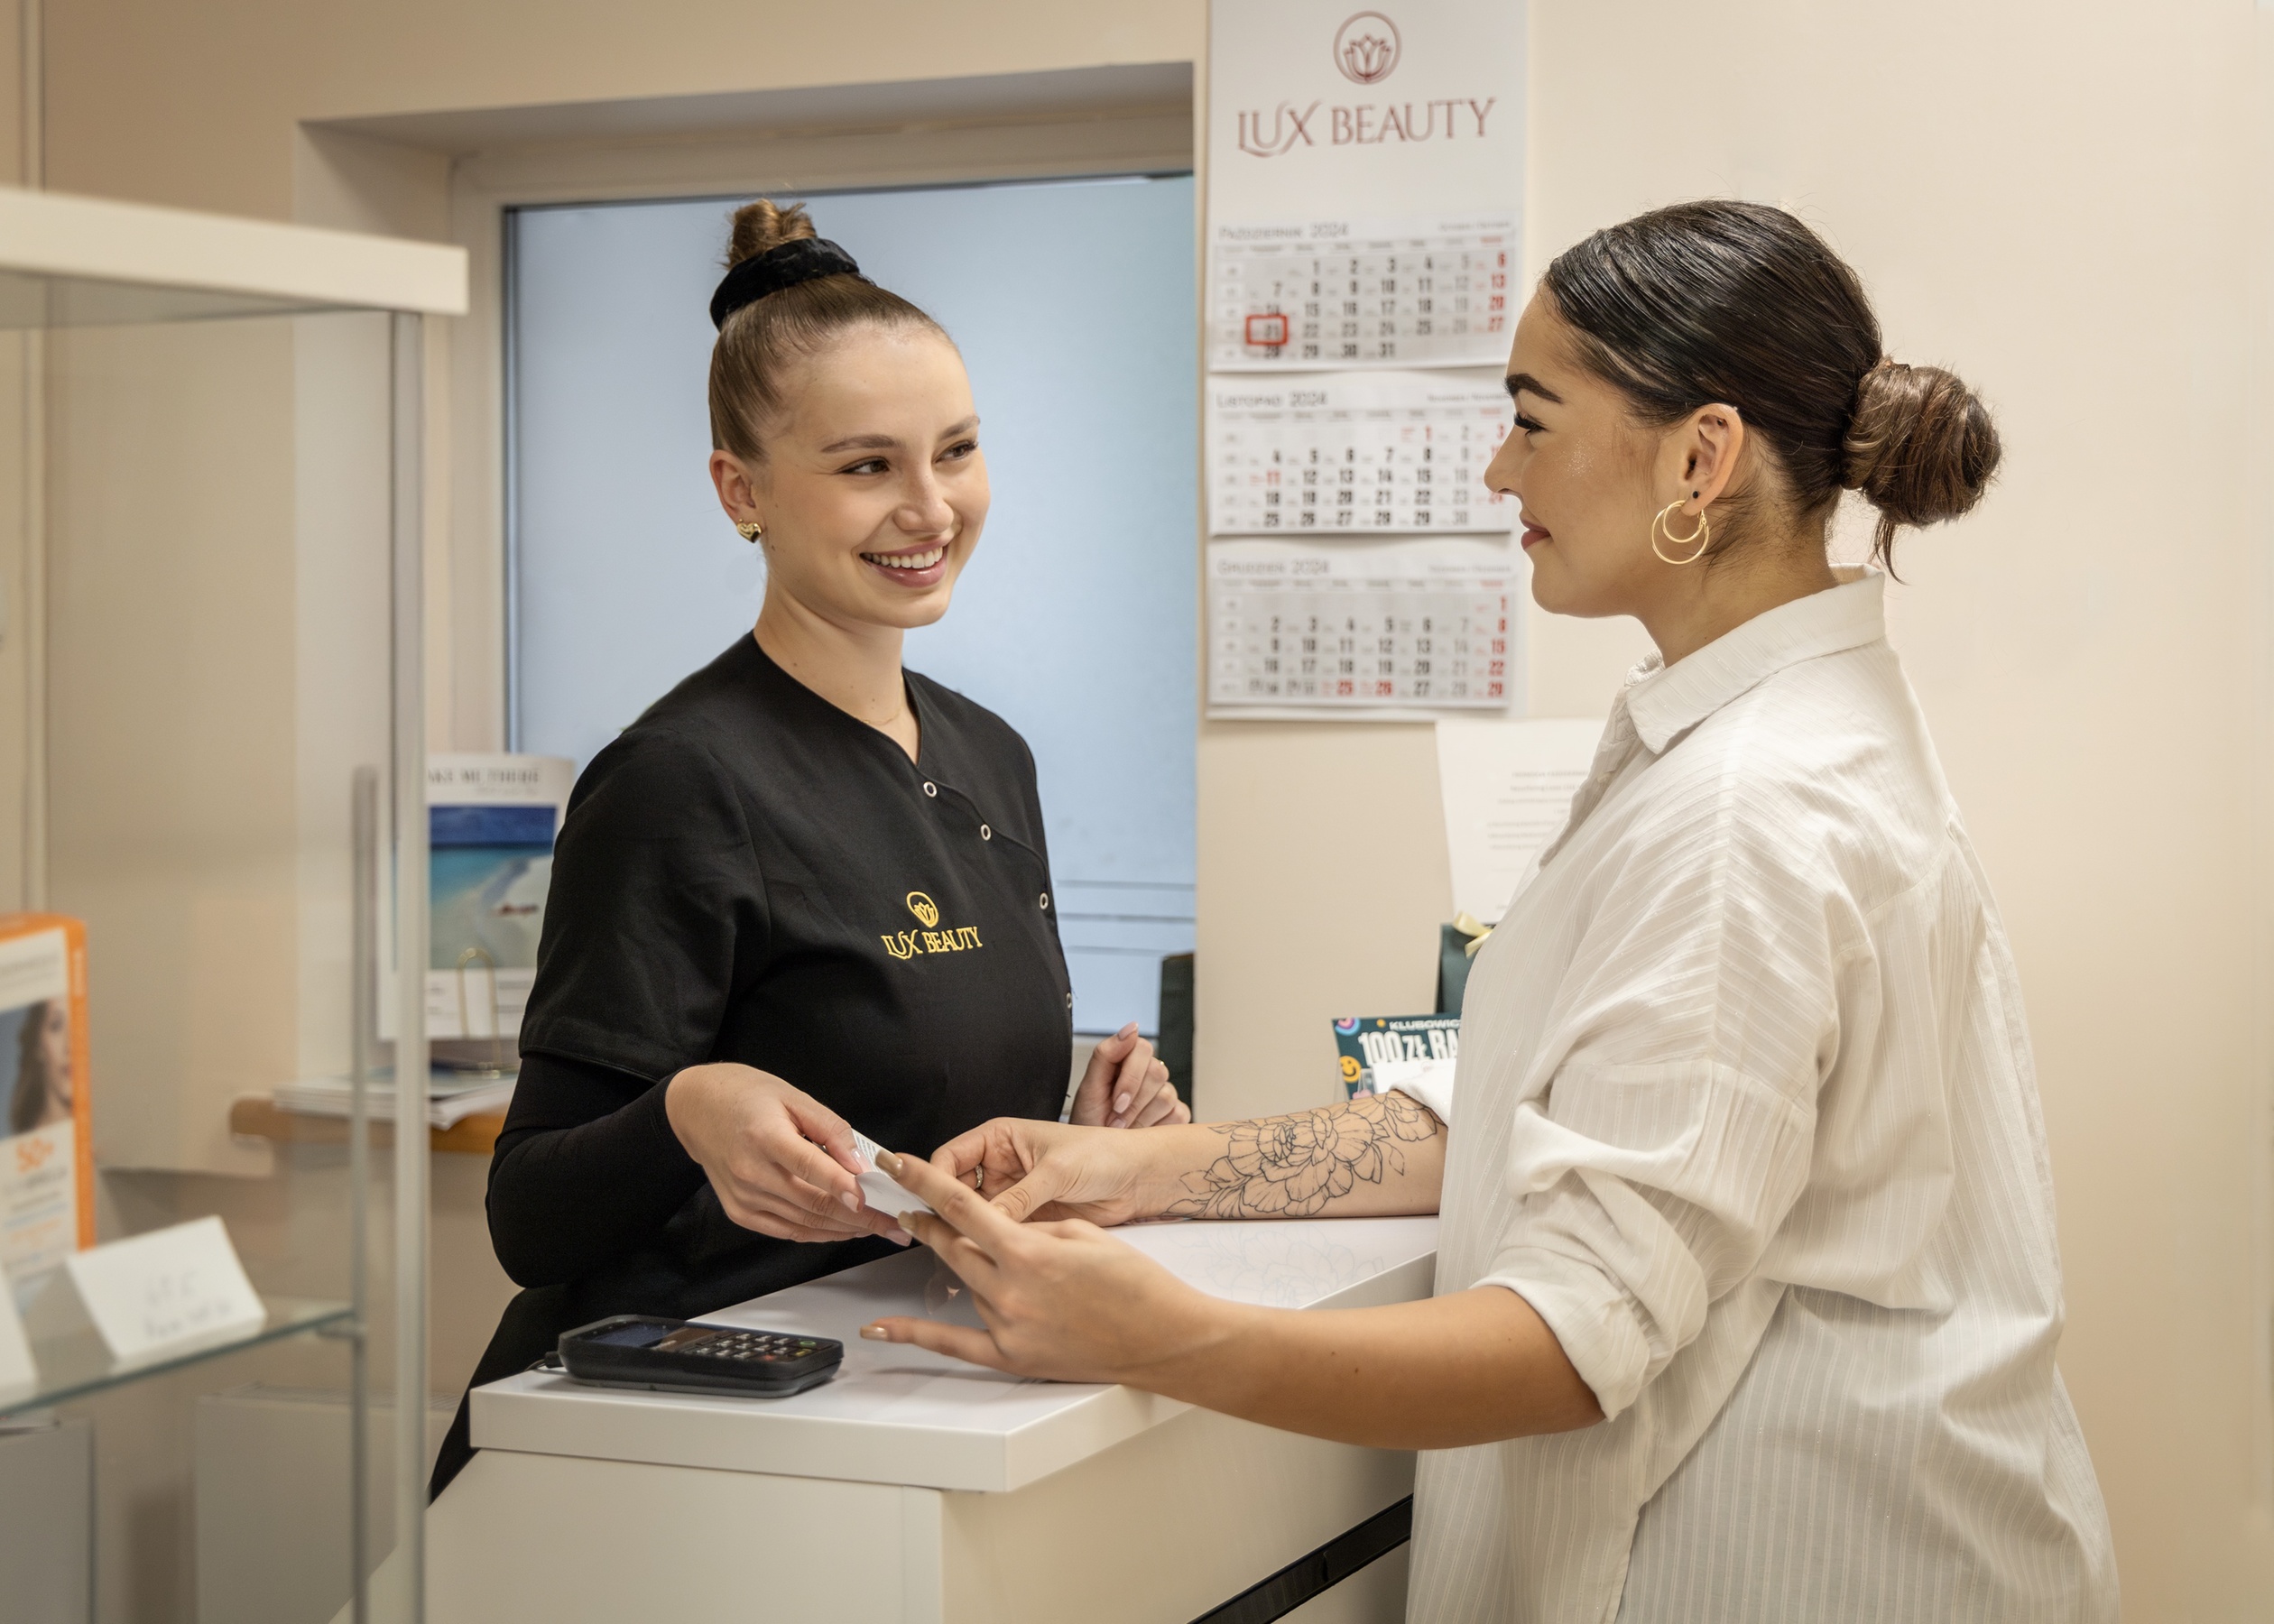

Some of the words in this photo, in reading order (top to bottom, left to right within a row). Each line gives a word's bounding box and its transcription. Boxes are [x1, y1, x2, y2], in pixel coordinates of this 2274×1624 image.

[1237, 98, 1322, 158] LUX
[1331, 96, 1497, 146] BEAUTY
[881, 929, 923, 960] LUX
[921, 926, 983, 953] BEAUTY
[1389, 1019, 1461, 1031] KLUBOWIC
[1357, 1030, 1404, 1066] 100
[1402, 1034, 1433, 1062] ZŁ
[1428, 1029, 1460, 1060] RA
